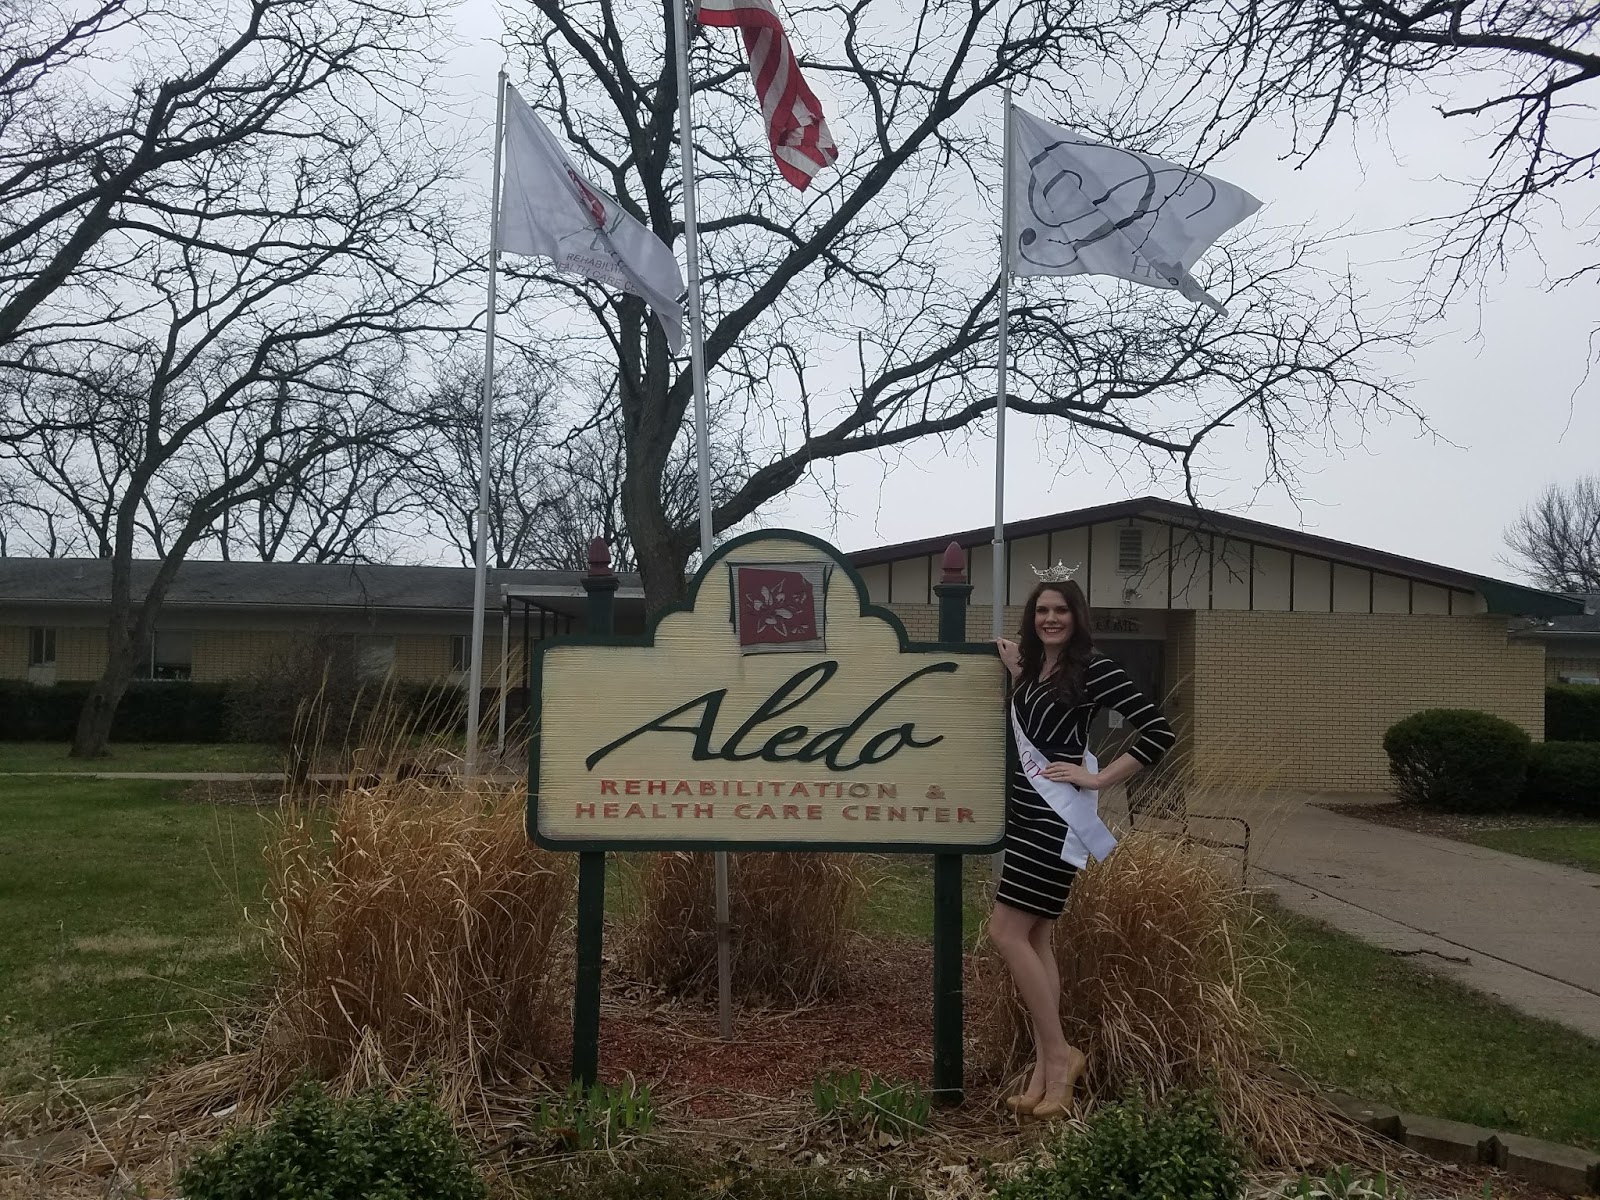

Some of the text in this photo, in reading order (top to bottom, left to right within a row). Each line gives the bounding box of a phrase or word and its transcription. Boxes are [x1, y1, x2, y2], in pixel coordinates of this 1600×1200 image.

[592, 270, 622, 288] CARE
[585, 660, 959, 772] Aledo
[1021, 751, 1042, 779] CITY
[600, 779, 947, 800] REHABILITATION &
[575, 802, 977, 824] HEALTH CARE CENTER
